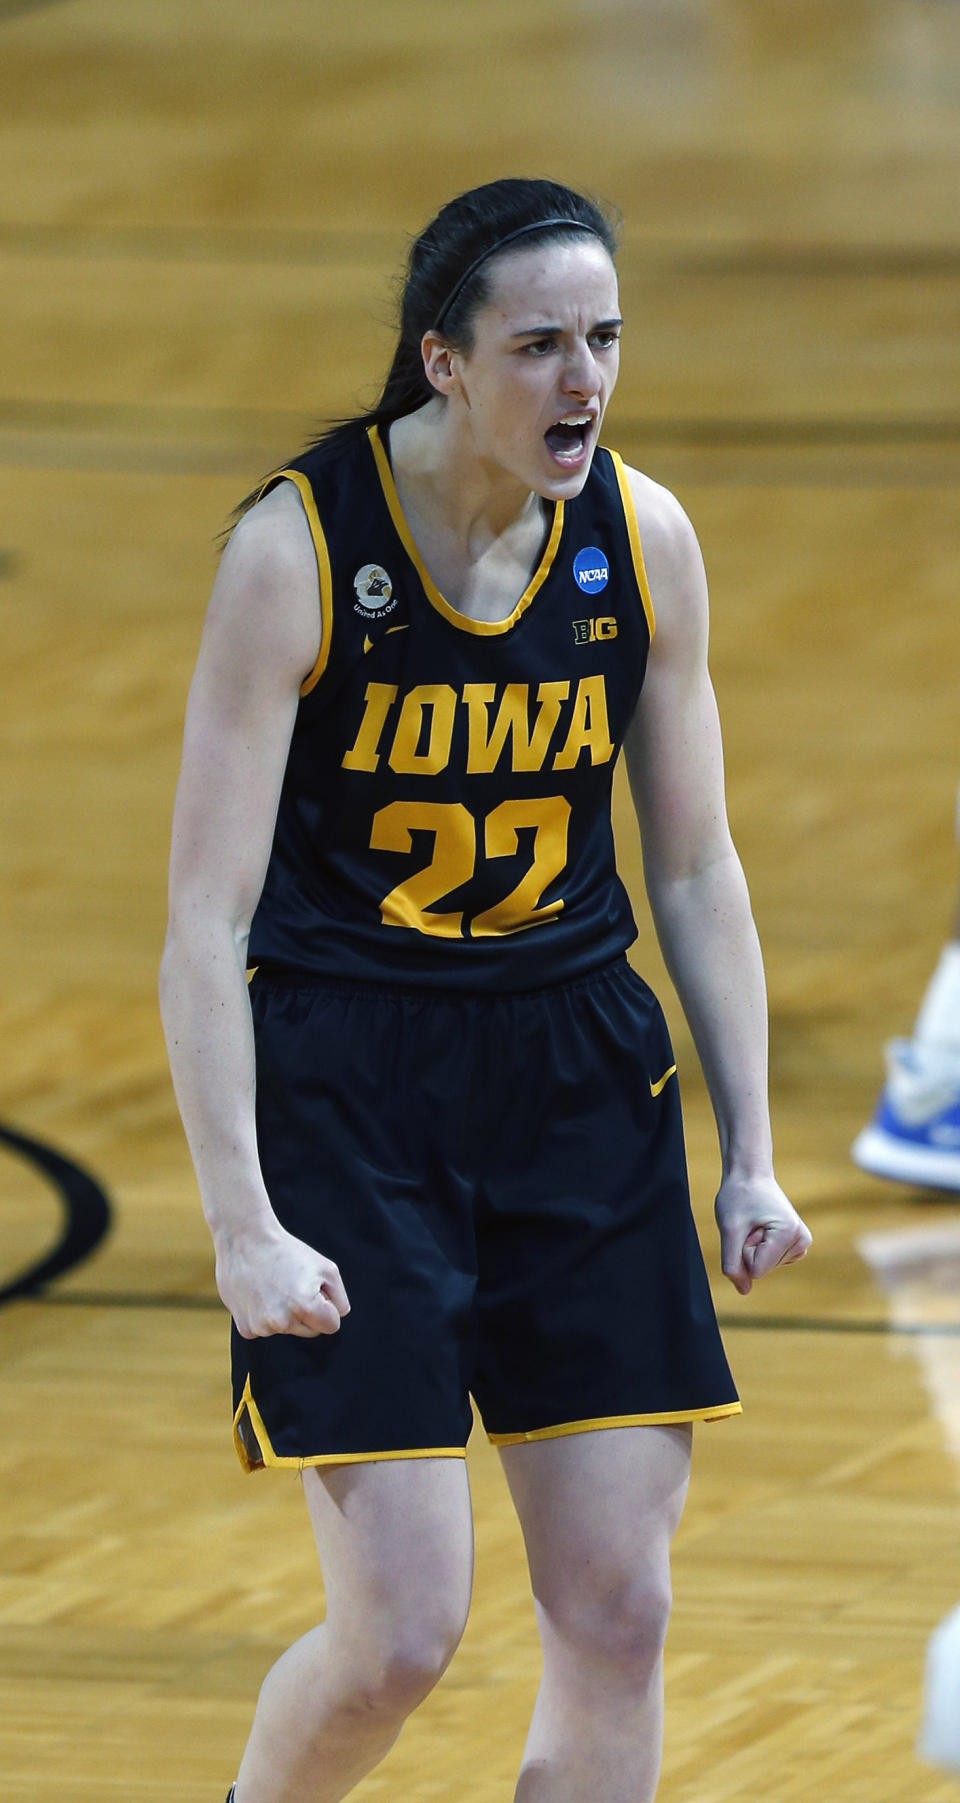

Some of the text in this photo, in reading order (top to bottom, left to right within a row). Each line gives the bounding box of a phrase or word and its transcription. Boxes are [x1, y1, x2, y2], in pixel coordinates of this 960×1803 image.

[578, 567, 608, 584] NCAA
[354, 604, 375, 618] United
[385, 600, 398, 613] One
[341, 674, 615, 776] IOWA
[368, 795, 572, 938] 22
